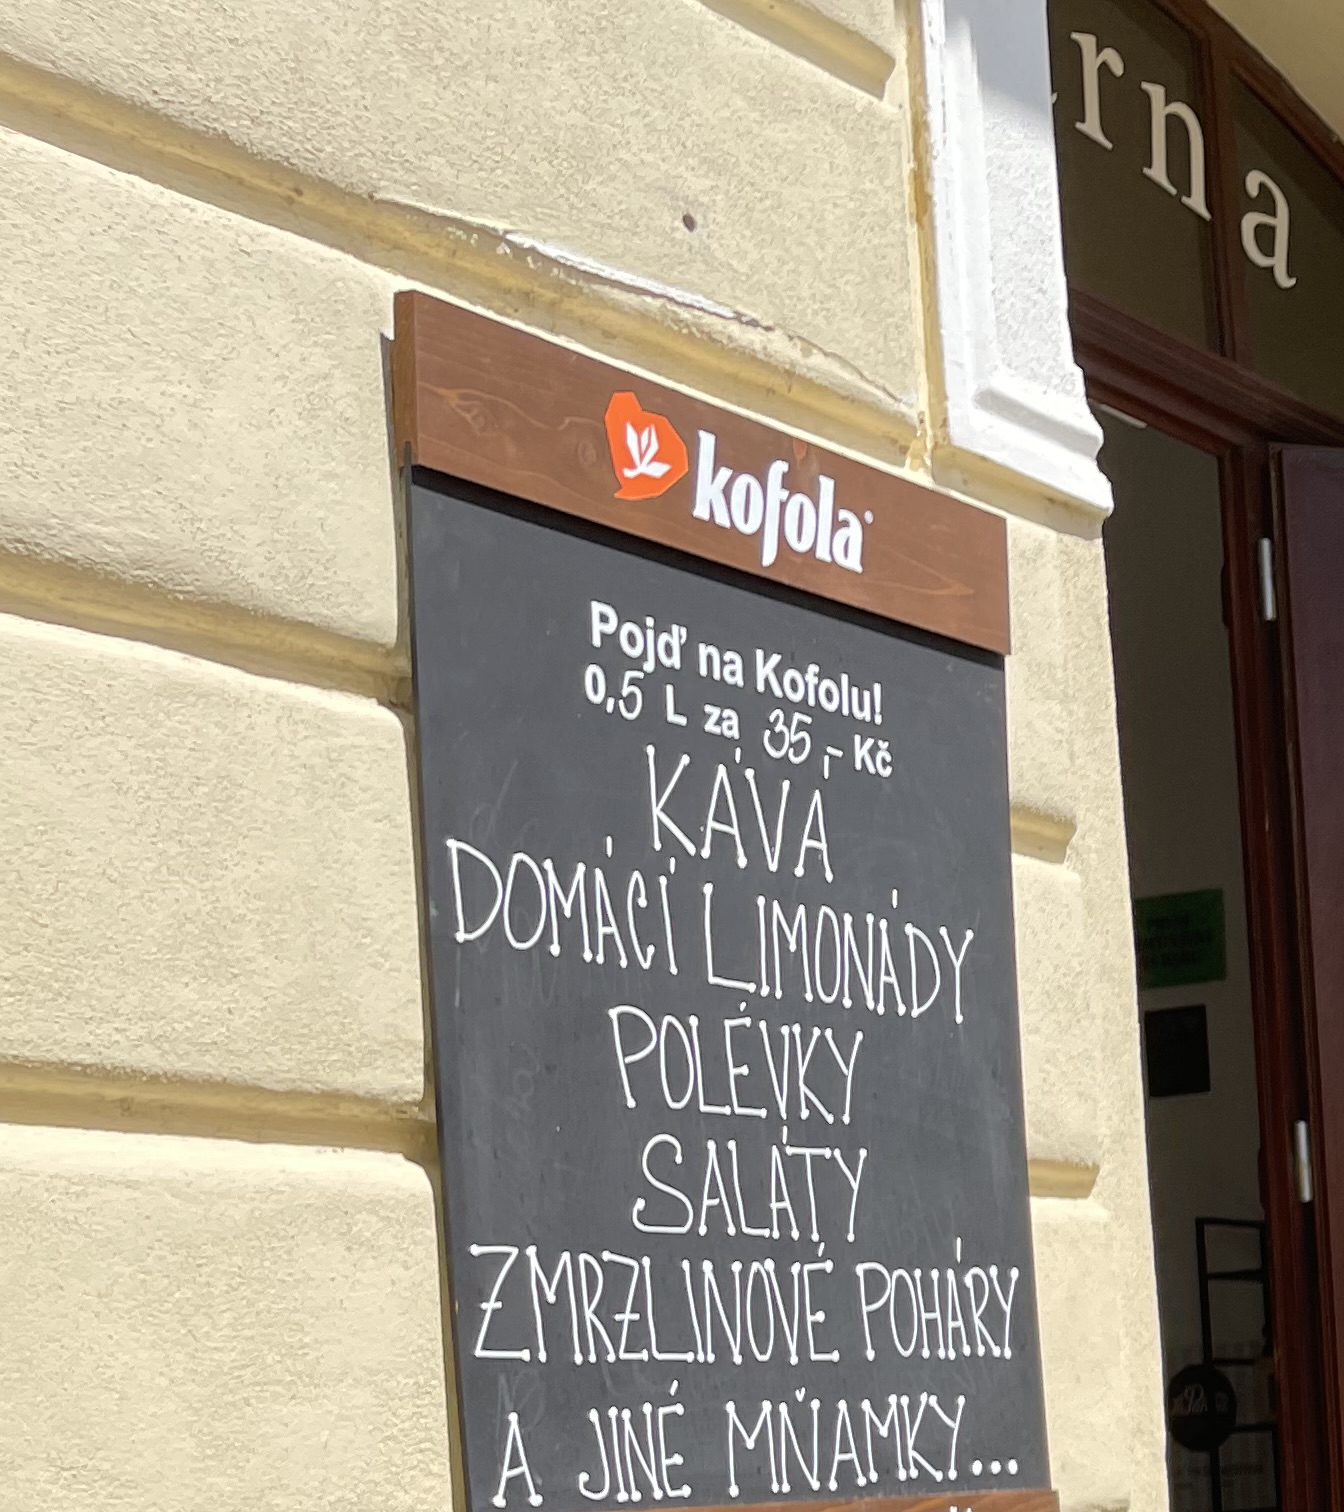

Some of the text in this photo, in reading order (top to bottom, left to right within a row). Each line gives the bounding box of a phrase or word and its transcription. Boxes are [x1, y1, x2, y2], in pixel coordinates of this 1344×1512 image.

[1051, 31, 1298, 290] rna
[693, 429, 866, 575] kofola
[584, 664, 645, 721] 0,5
[665, 683, 688, 726] L
[703, 706, 741, 740] za
[854, 735, 894, 779] Kč
[590, 600, 884, 725] Pojď na Kofolu!
[645, 744, 835, 884] KÁVA
[446, 836, 974, 1024] DOMÁCÍ LIMONÁDY
[607, 1001, 864, 1125] POLÉVKY
[631, 1126, 868, 1243] SALÁTY
[469, 1237, 1020, 1367] ZMRZLINOVÉ POHÁRY
[492, 1410, 544, 1508] A
[577, 1379, 692, 1503] JINÉ
